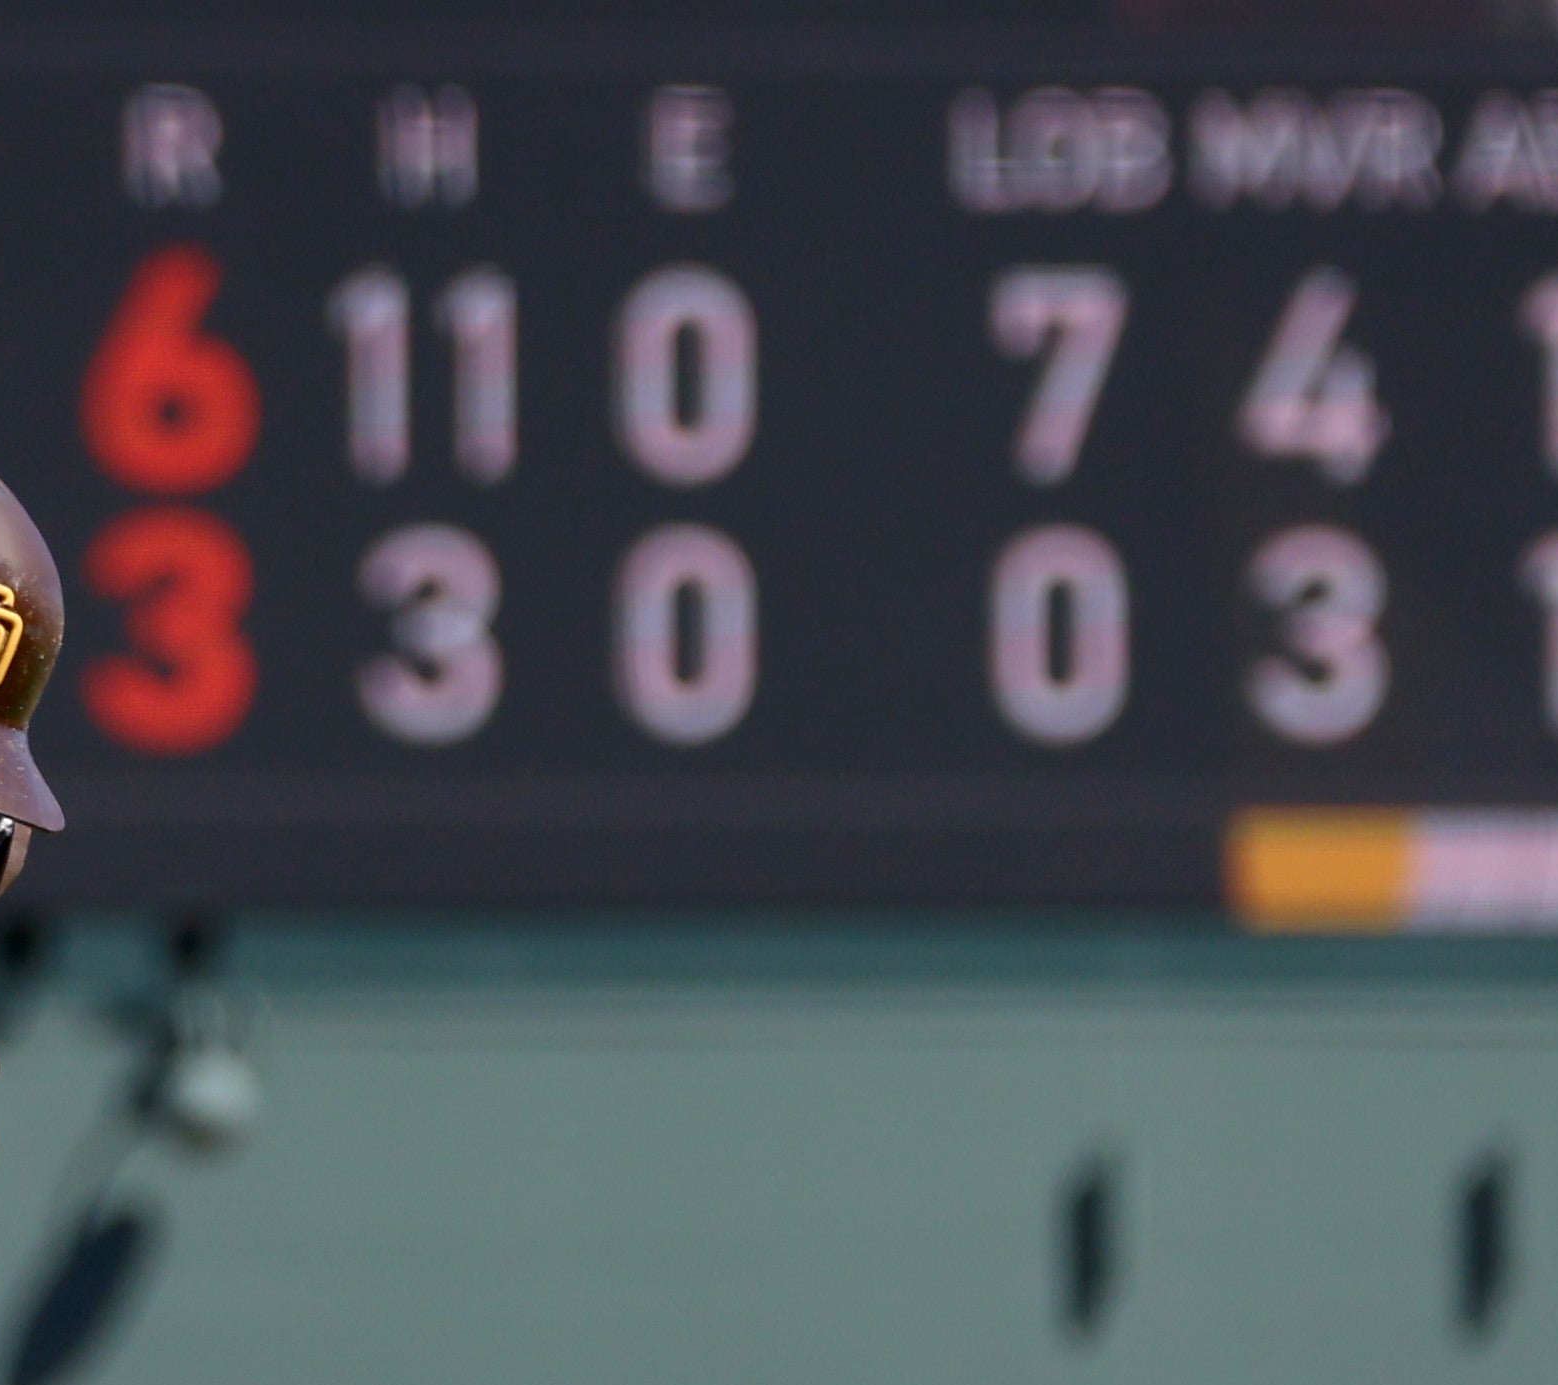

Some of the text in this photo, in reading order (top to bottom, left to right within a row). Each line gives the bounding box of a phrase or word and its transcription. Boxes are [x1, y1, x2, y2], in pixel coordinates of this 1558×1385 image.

[124, 84, 223, 202] R
[378, 86, 477, 202] H
[646, 84, 732, 207] E
[84, 248, 258, 492] 6
[330, 268, 517, 480] 11
[619, 269, 758, 483] 0
[993, 269, 1127, 480] 7
[1244, 269, 1383, 479] 4
[87, 508, 256, 750] 3
[366, 525, 503, 742] 3
[619, 526, 758, 743] 0
[991, 525, 1130, 742] 0
[1254, 526, 1388, 743] 3
